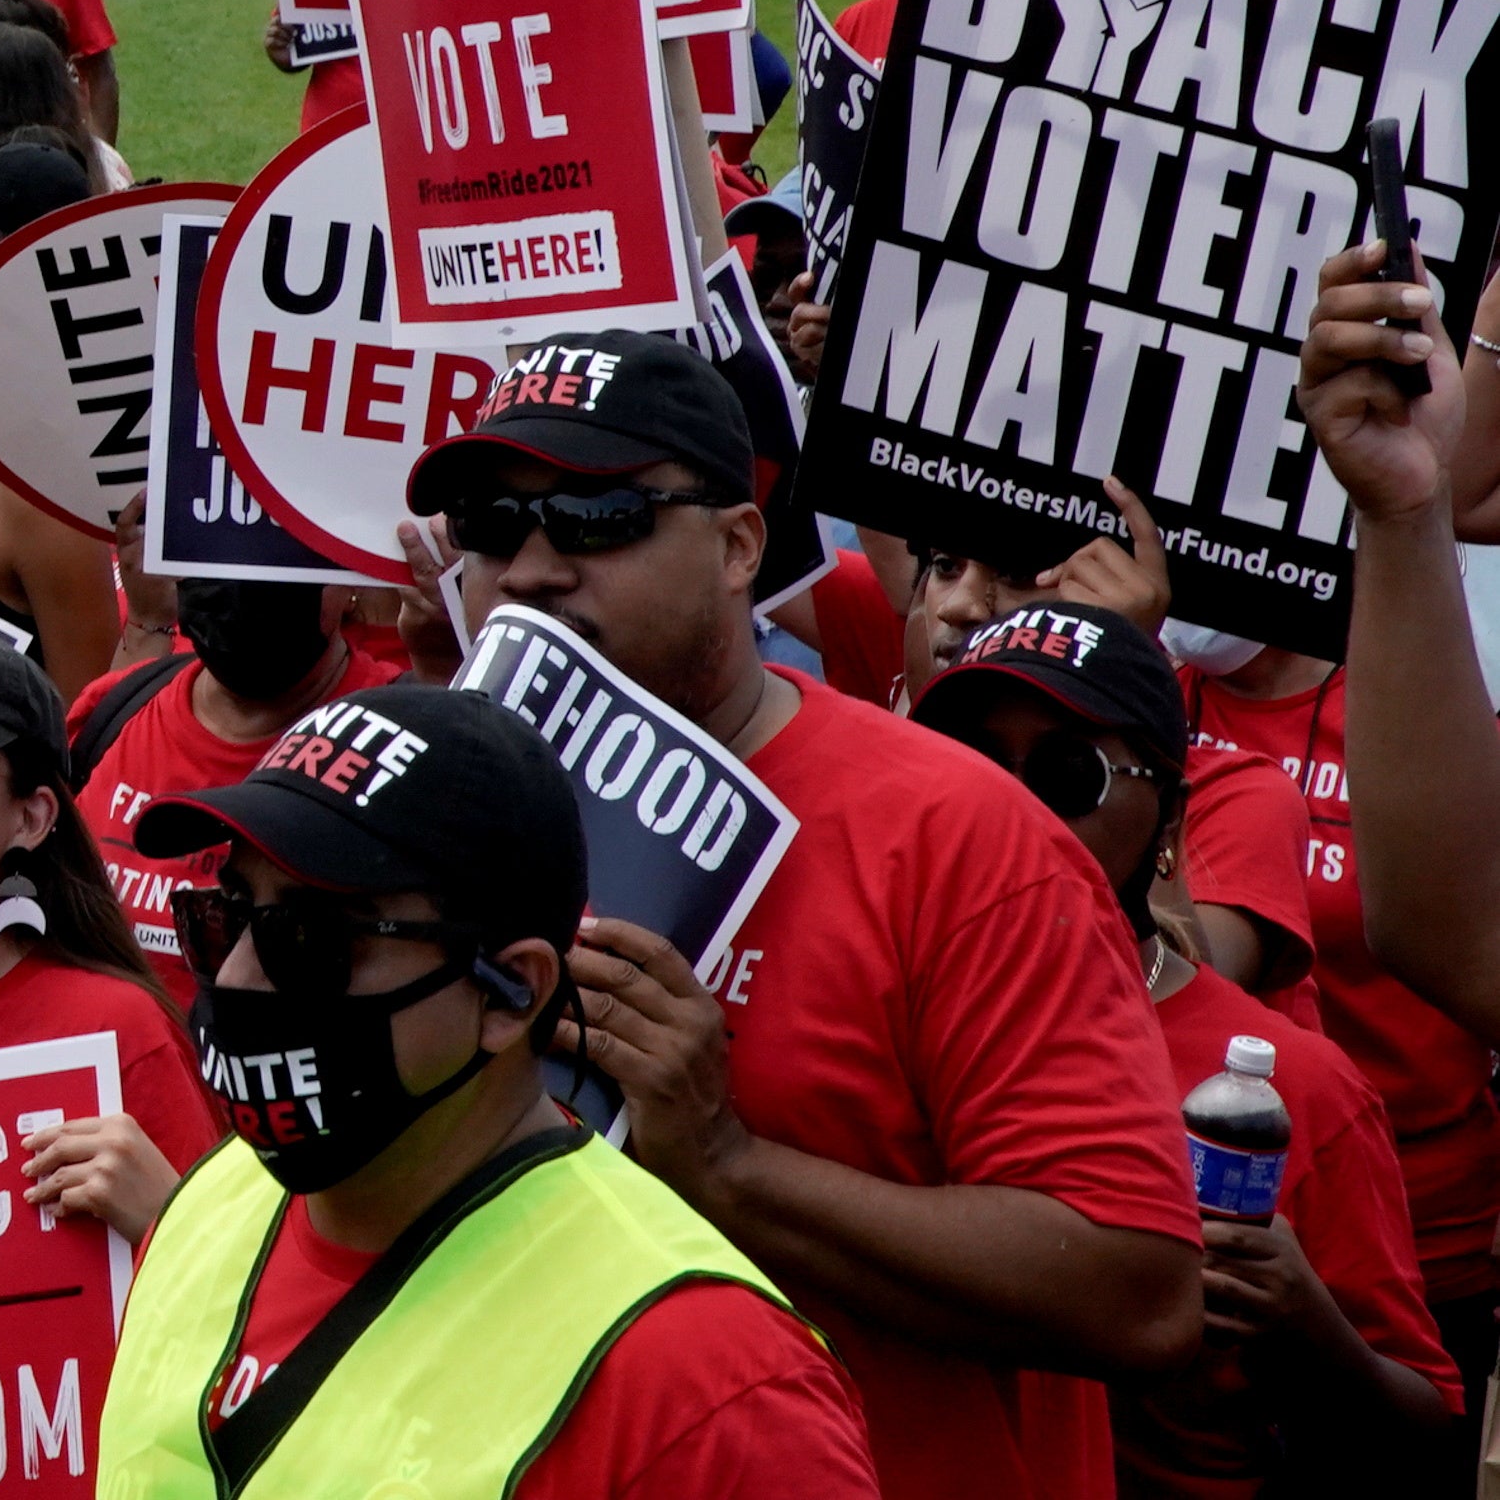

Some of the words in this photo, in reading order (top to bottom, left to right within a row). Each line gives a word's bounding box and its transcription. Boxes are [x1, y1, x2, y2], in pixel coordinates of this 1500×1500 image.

[402, 12, 570, 156] VOTE
[418, 160, 593, 206] #FreedomRide2021
[426, 228, 606, 286] UNITEHERE!
[840, 239, 1359, 551] MATTE
[868, 436, 1338, 602] BlackVotersMatrFund.org
